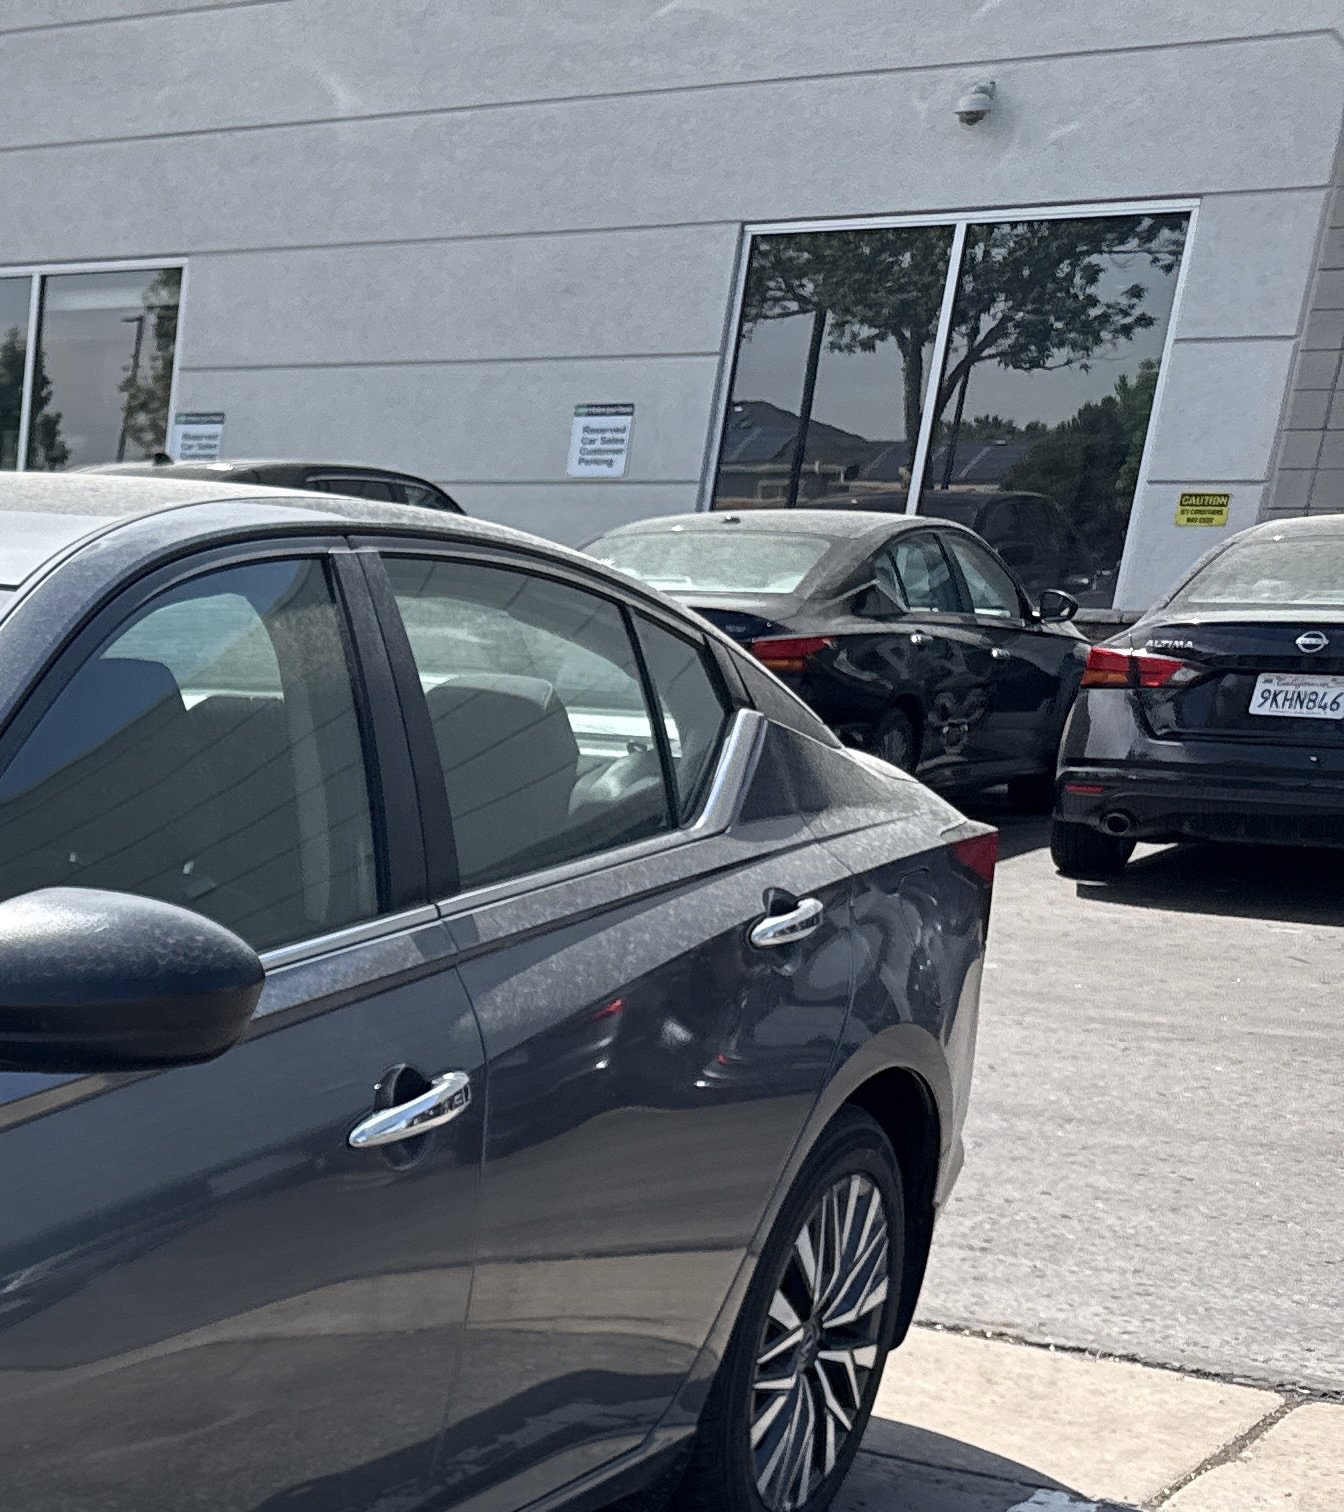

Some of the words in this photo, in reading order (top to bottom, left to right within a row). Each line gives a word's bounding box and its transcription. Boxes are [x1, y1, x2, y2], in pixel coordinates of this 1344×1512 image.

[1182, 495, 1229, 505] CAUTION
[1145, 639, 1194, 648] ALTIMA
[1257, 688, 1344, 711] 9KHN846
